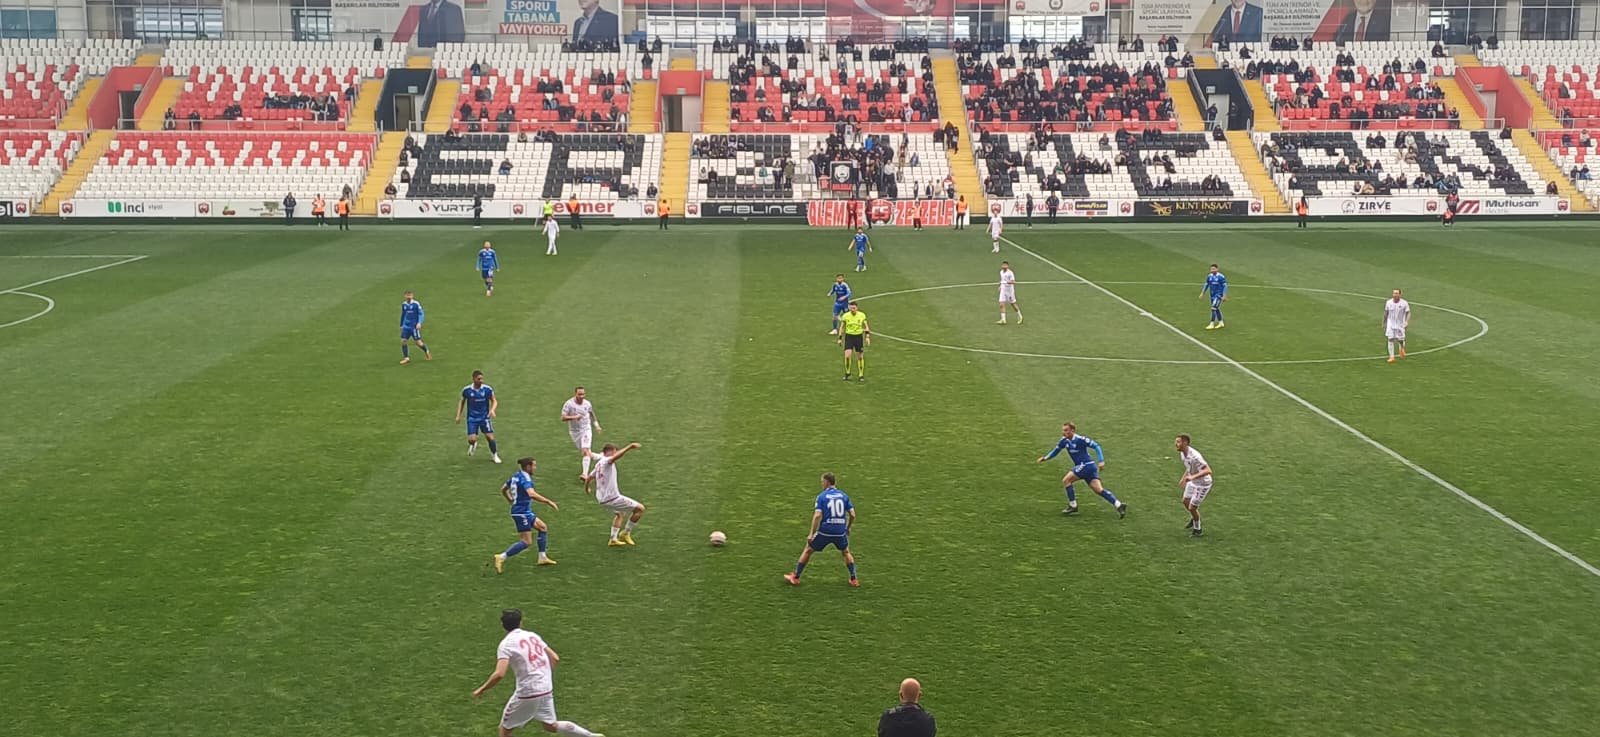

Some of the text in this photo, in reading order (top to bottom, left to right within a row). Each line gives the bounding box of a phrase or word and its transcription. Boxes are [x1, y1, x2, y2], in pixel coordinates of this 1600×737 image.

[511, 1, 550, 11] SPORU
[507, 13, 556, 22] TABANA
[500, 24, 566, 34] YAYIYORUZ
[123, 201, 145, 213] inci
[718, 205, 797, 214] FIBLINE
[827, 499, 845, 518] 10
[519, 635, 544, 661] 28
